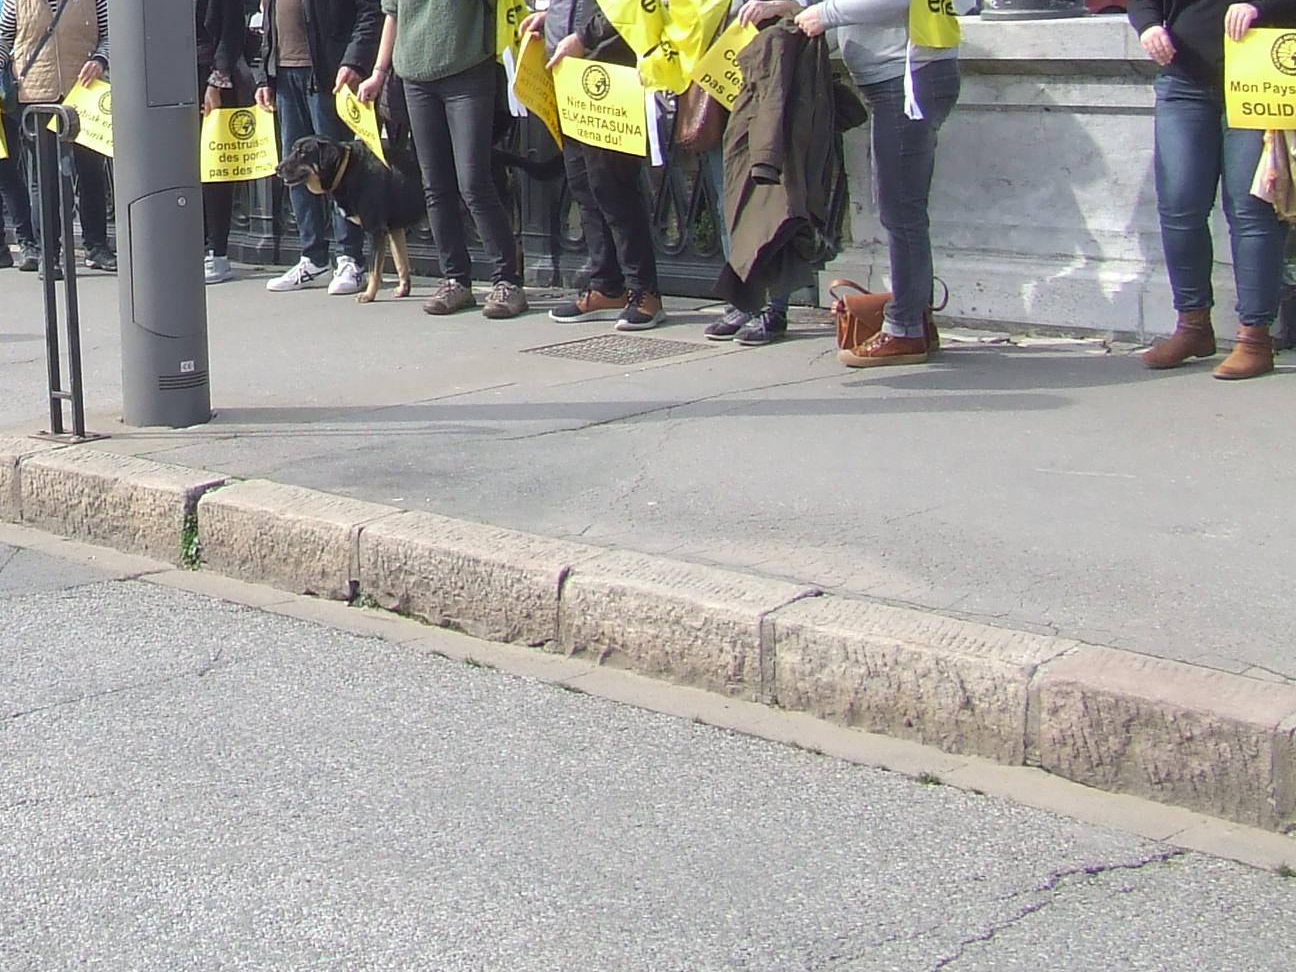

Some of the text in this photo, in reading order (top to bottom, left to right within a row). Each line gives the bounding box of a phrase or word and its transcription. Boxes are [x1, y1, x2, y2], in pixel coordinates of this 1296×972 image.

[700, 73, 738, 103] pas d
[1230, 81, 1296, 97] Mon Pays
[567, 95, 629, 119] Nire herriak
[1242, 101, 1296, 117] SOLID
[561, 108, 643, 138] ELKARTASUNA
[576, 125, 623, 147] izena du!
[218, 152, 239, 163] des
[209, 168, 229, 179] pas
[232, 165, 253, 177] des
